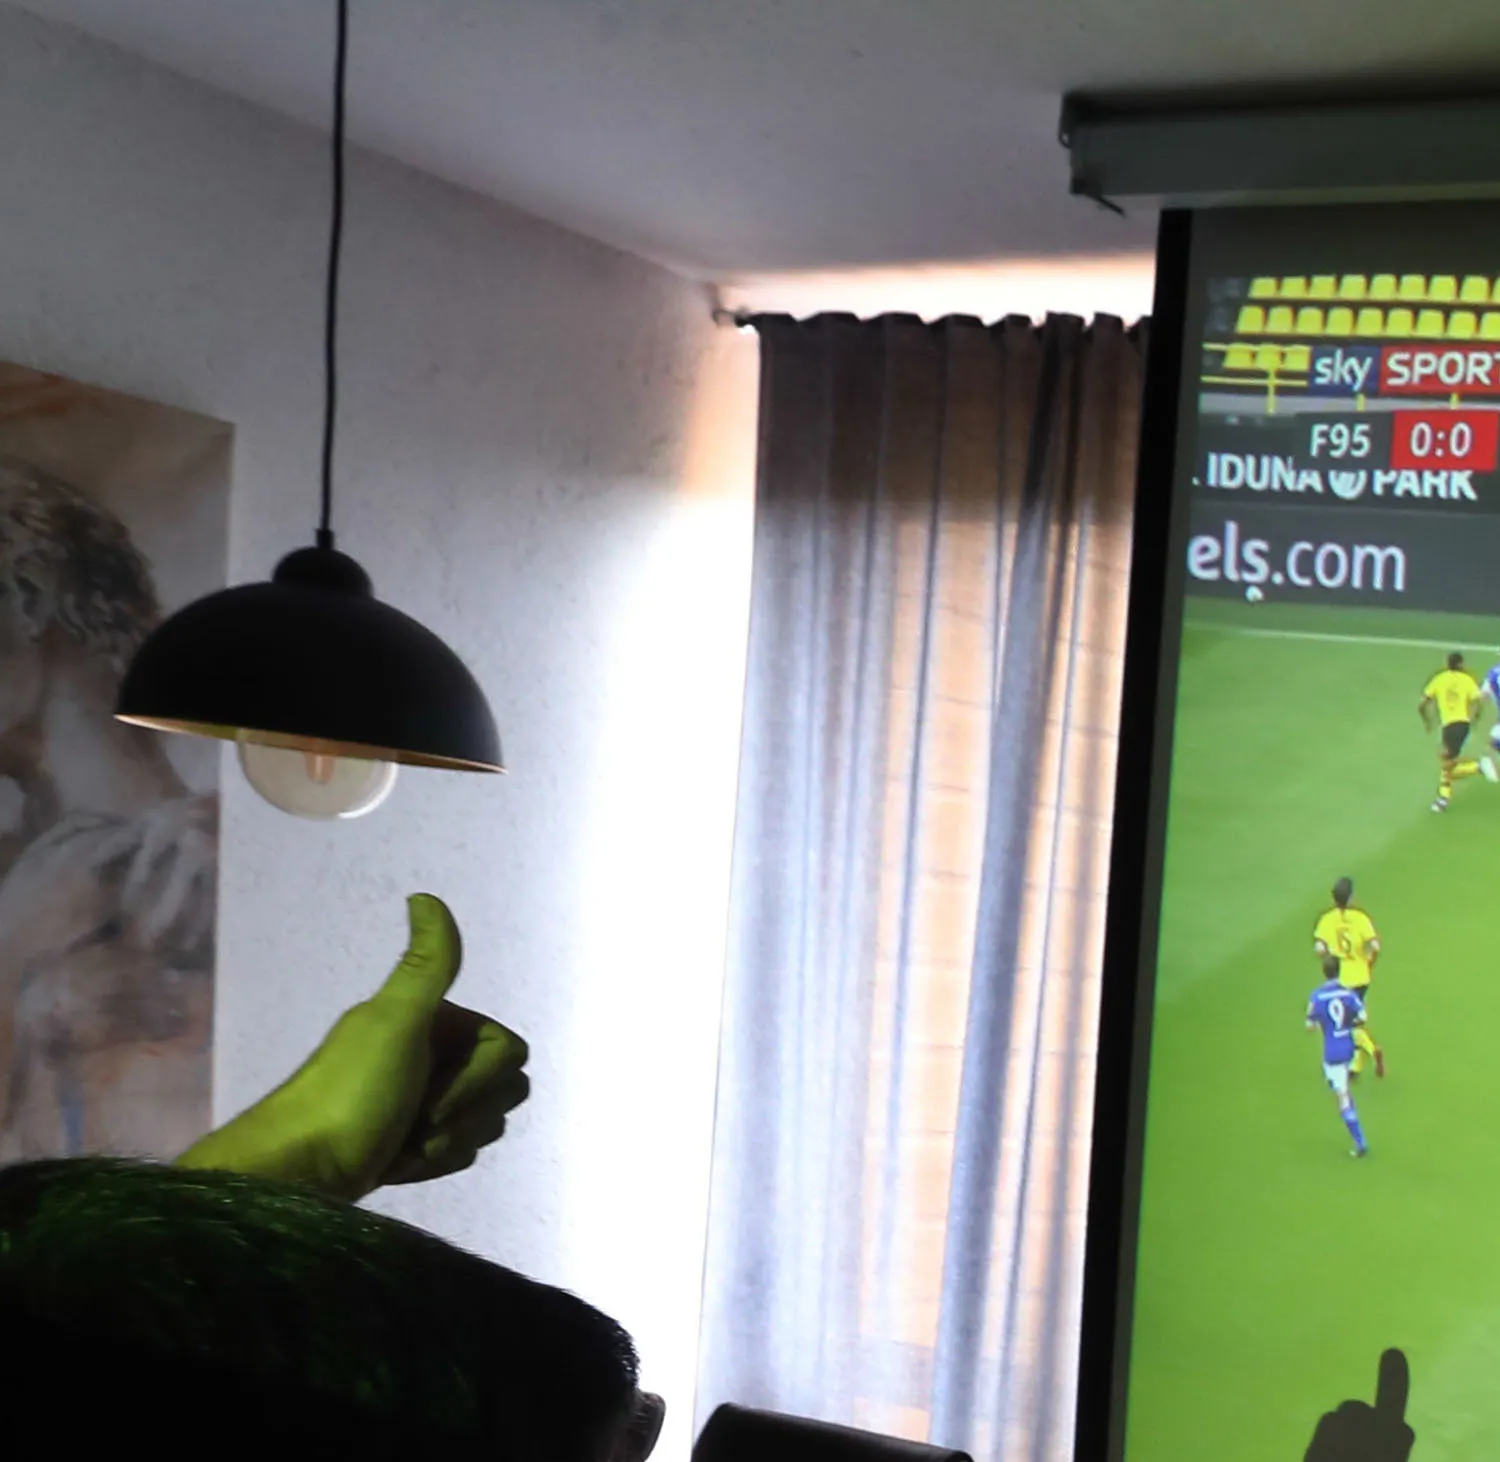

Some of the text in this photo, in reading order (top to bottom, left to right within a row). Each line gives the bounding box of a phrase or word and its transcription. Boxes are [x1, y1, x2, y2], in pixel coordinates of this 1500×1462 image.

[1315, 353, 1372, 391] sky
[1309, 423, 1371, 458] F95
[1410, 423, 1472, 458] 0:0
[1207, 452, 1324, 494] IDUNA
[1187, 520, 1407, 592] els.com
[1328, 998, 1345, 1030] 9
